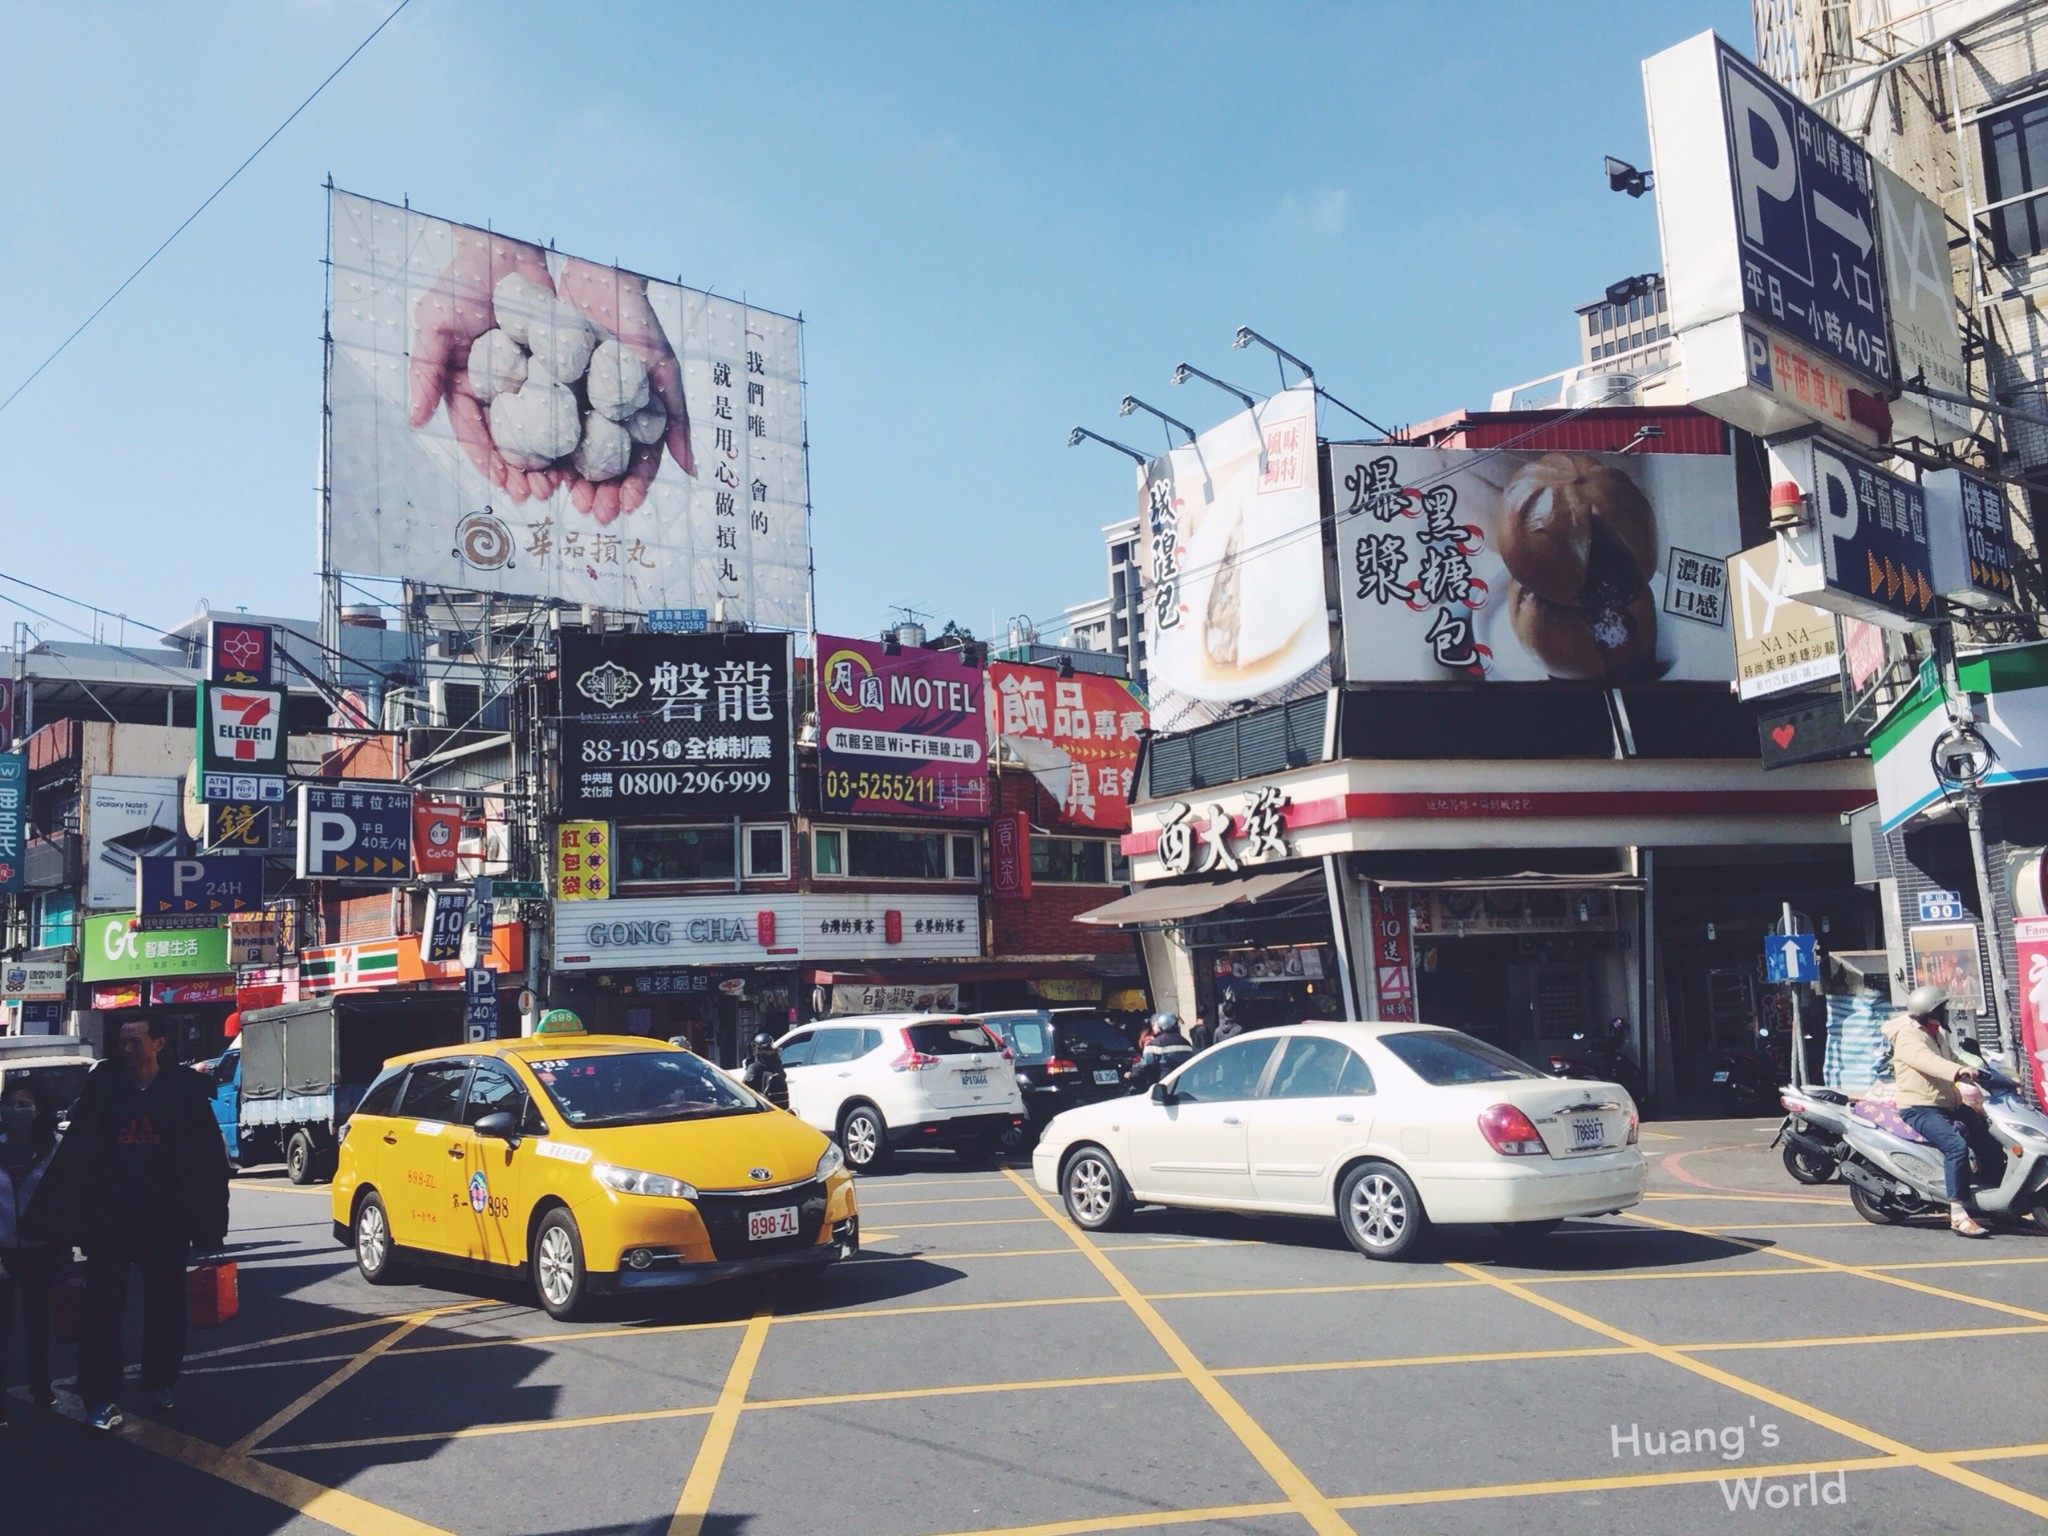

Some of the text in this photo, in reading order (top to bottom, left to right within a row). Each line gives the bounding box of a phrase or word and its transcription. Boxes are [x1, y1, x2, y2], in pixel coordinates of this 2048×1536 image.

[1727, 57, 1796, 246] P
[1799, 110, 1867, 197] 中山停車場
[1832, 251, 1874, 314] 入口
[1744, 260, 1888, 379] 平日一小時40元
[1748, 338, 1766, 378] P
[1773, 344, 1846, 422] 平面車位
[1813, 447, 1858, 582] P
[1858, 469, 1926, 544] 平面車位
[1963, 479, 2003, 534] 機車
[1149, 478, 1180, 630] 城隍包
[1419, 484, 1480, 667] 黑糖包
[1676, 591, 1720, 619] 口感
[1761, 627, 1810, 655] NA NA
[650, 660, 774, 722] 磐龍
[831, 661, 885, 712] 月圓
[890, 675, 977, 713] MOTEL
[1000, 673, 1091, 740] 飾品
[685, 736, 772, 760] 全棟制震
[835, 732, 974, 759] 本館全區Wi-Fi無線上網
[209, 778, 228, 786] ATM
[235, 786, 255, 794] Wi-Fi
[581, 773, 613, 784] 中央路
[581, 786, 613, 798] 文化街
[619, 771, 771, 795] 0800-296-999
[827, 770, 935, 803] 03-5255211
[96, 800, 124, 809] Galaxy
[311, 791, 409, 810] 平面車位 24H
[216, 804, 260, 845] 鏡
[362, 823, 383, 834] 平日
[309, 811, 357, 872] P
[361, 837, 407, 850] 40元/H
[997, 822, 1014, 885] 貢茶
[561, 829, 581, 894] 紅包袋
[173, 861, 204, 896] P
[206, 882, 242, 896] 24H
[438, 896, 465, 909] 機車
[1929, 905, 1953, 918] 90
[436, 911, 463, 933] 10
[586, 918, 750, 947] GONG CHA
[820, 918, 875, 934] 台灣的貢茶
[914, 918, 965, 934] 世界的好茶
[144, 938, 198, 958] 智慧生活
[432, 933, 460, 946] 元/H
[473, 970, 486, 994] P
[25, 1005, 58, 1018] 平日
[550, 1012, 573, 1023] 898
[530, 1059, 569, 1069] 898
[407, 1169, 437, 1190] 898-ZL
[488, 1195, 509, 1219] 898
